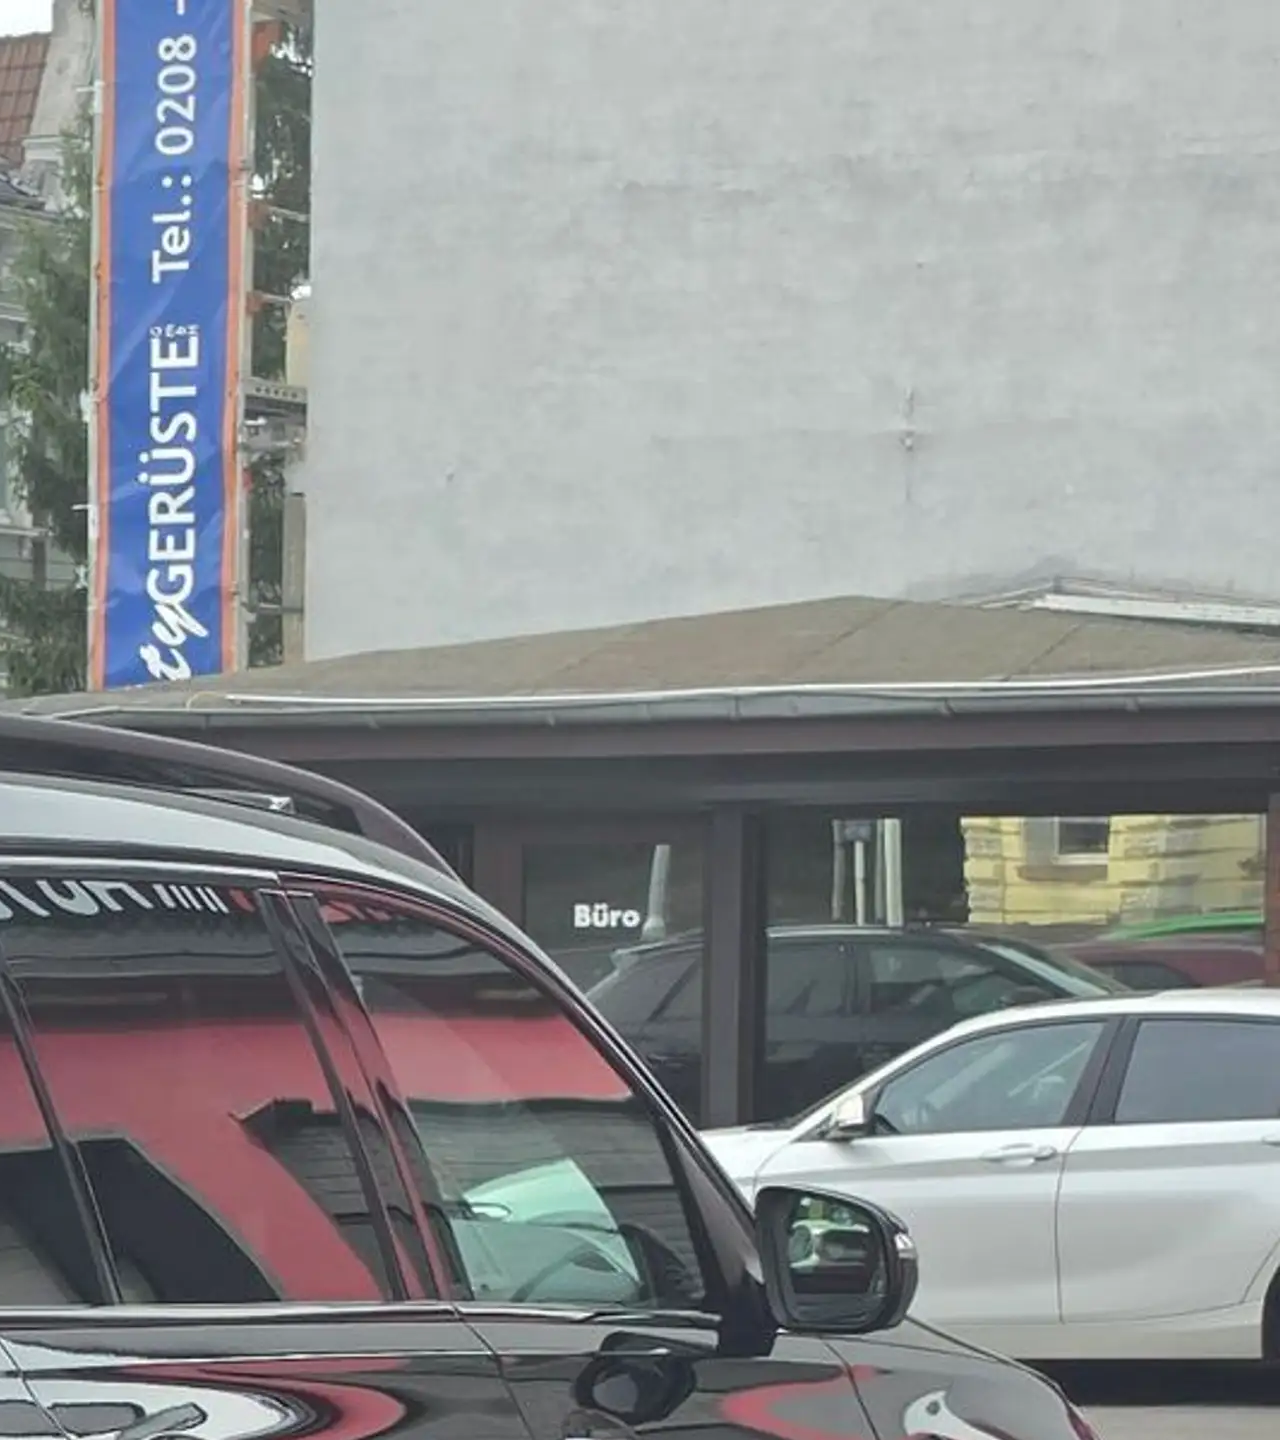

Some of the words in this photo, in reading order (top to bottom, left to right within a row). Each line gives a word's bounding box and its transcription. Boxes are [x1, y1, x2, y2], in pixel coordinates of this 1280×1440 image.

[154, 34, 197, 156] 0208
[151, 174, 192, 284] Tel.:
[574, 902, 641, 928] Büro
